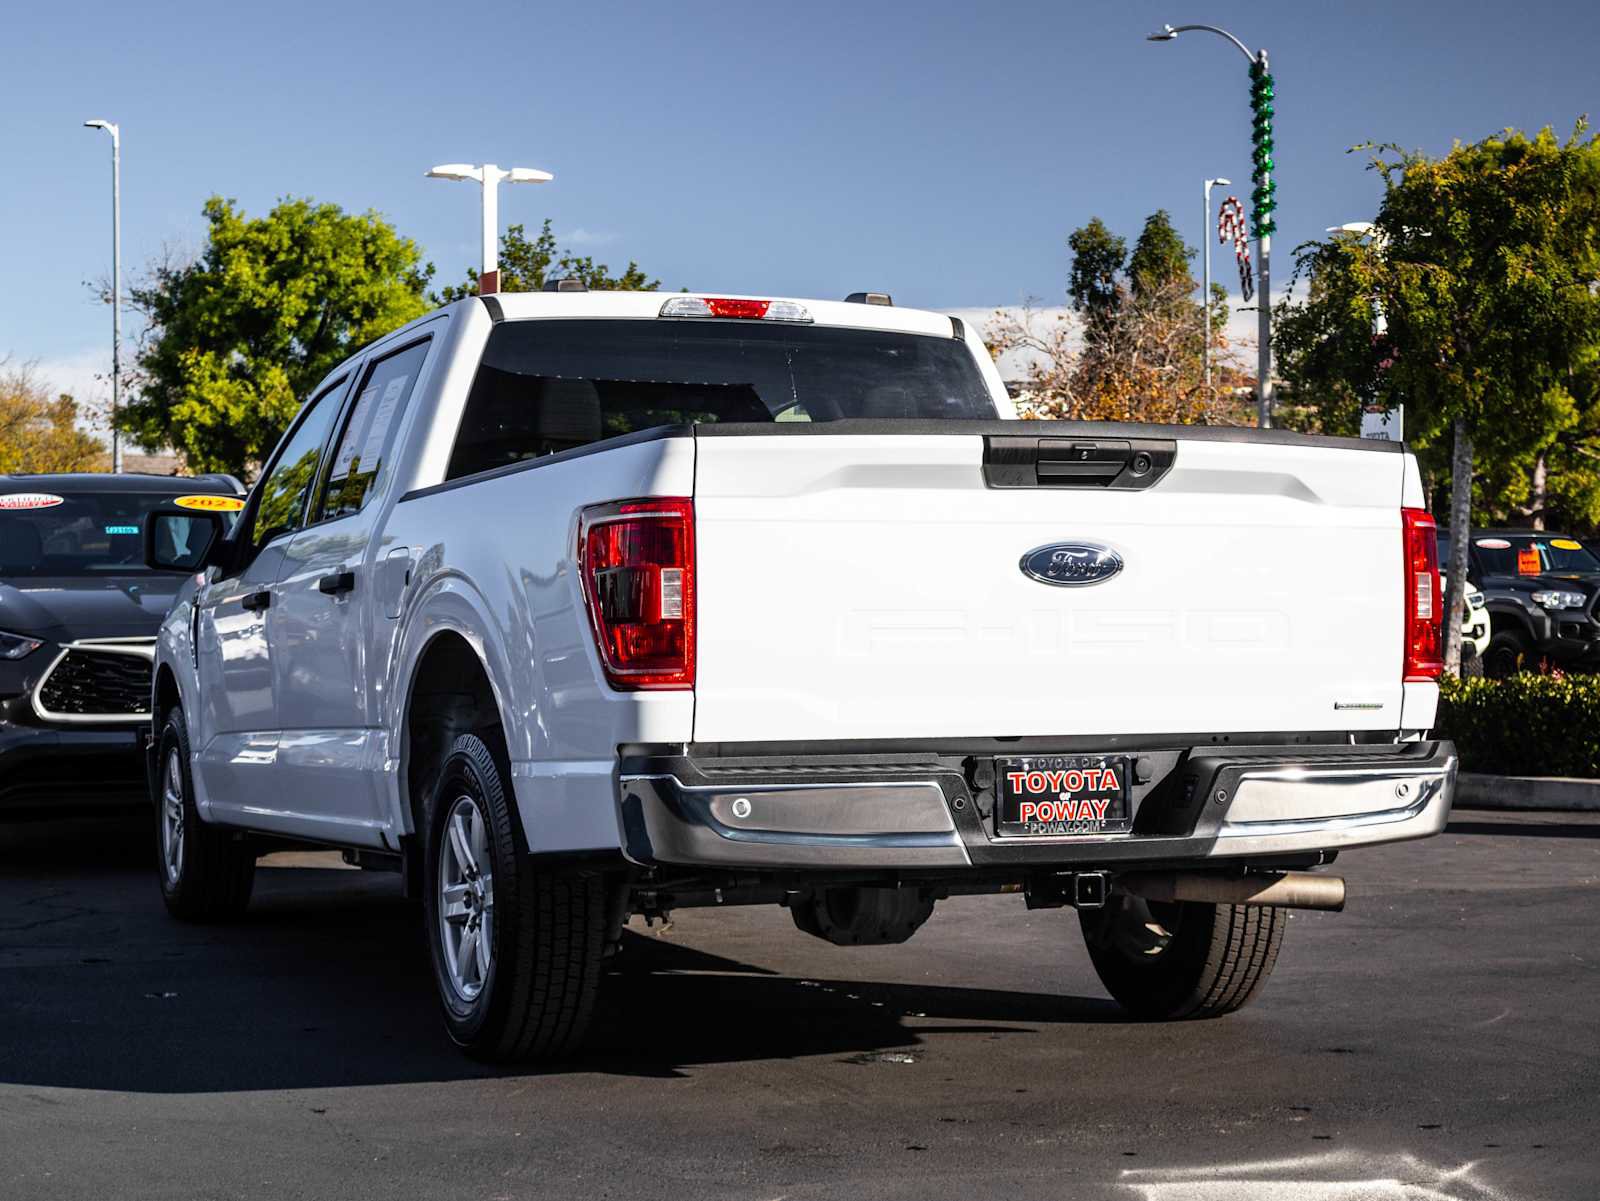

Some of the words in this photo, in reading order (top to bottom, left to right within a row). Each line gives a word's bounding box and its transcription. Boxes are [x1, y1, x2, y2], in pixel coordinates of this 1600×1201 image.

[1047, 550, 1106, 577] Ford
[1031, 758, 1077, 769] TOYOTA
[1007, 769, 1120, 794] TOYOTA
[1020, 799, 1110, 823] POWAY
